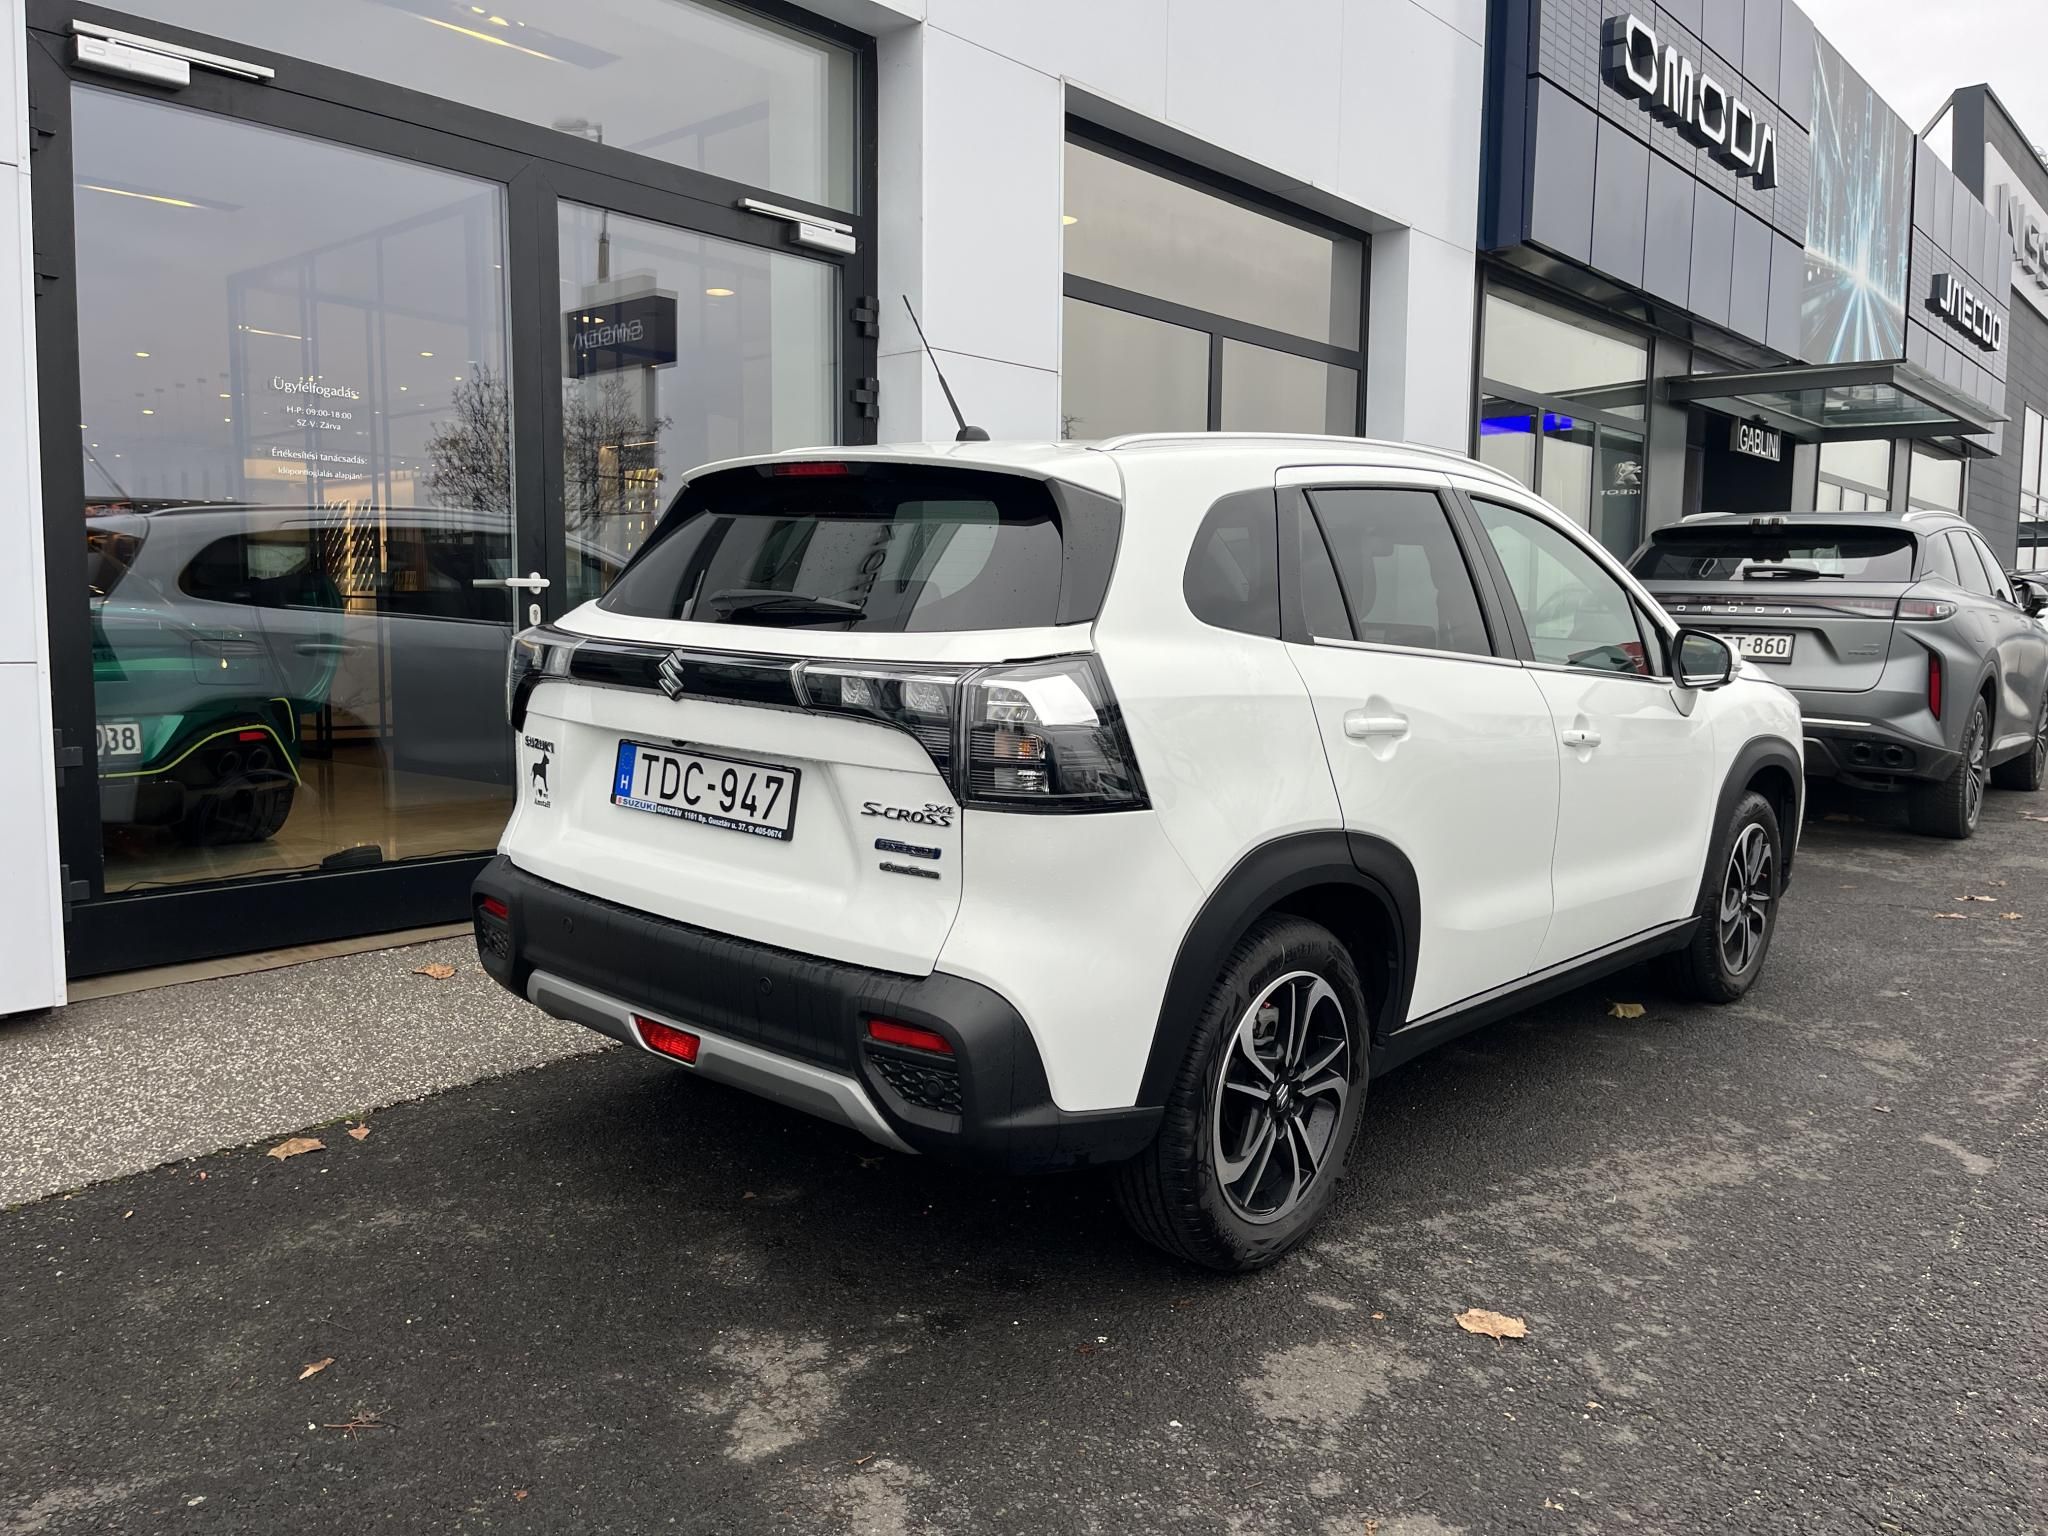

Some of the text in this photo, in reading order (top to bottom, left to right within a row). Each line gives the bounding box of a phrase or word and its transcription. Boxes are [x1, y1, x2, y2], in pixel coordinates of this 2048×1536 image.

[1626, 14, 1778, 187] OMODA
[1940, 274, 2001, 351] JAECOO
[319, 421, 341, 431] Zárva
[1740, 425, 1779, 459] GABLINI
[1676, 605, 1792, 614] OMODA
[1723, 636, 1787, 655] T-860
[525, 735, 555, 753] SUZUKI
[620, 774, 629, 790] H
[642, 753, 784, 820] TDC-947
[622, 798, 656, 811] SUZUKI
[657, 805, 683, 817] GUSZTÁV
[708, 817, 731, 828] Gusztáv
[860, 801, 954, 827] S-CROSS
[922, 803, 954, 815] SX4
